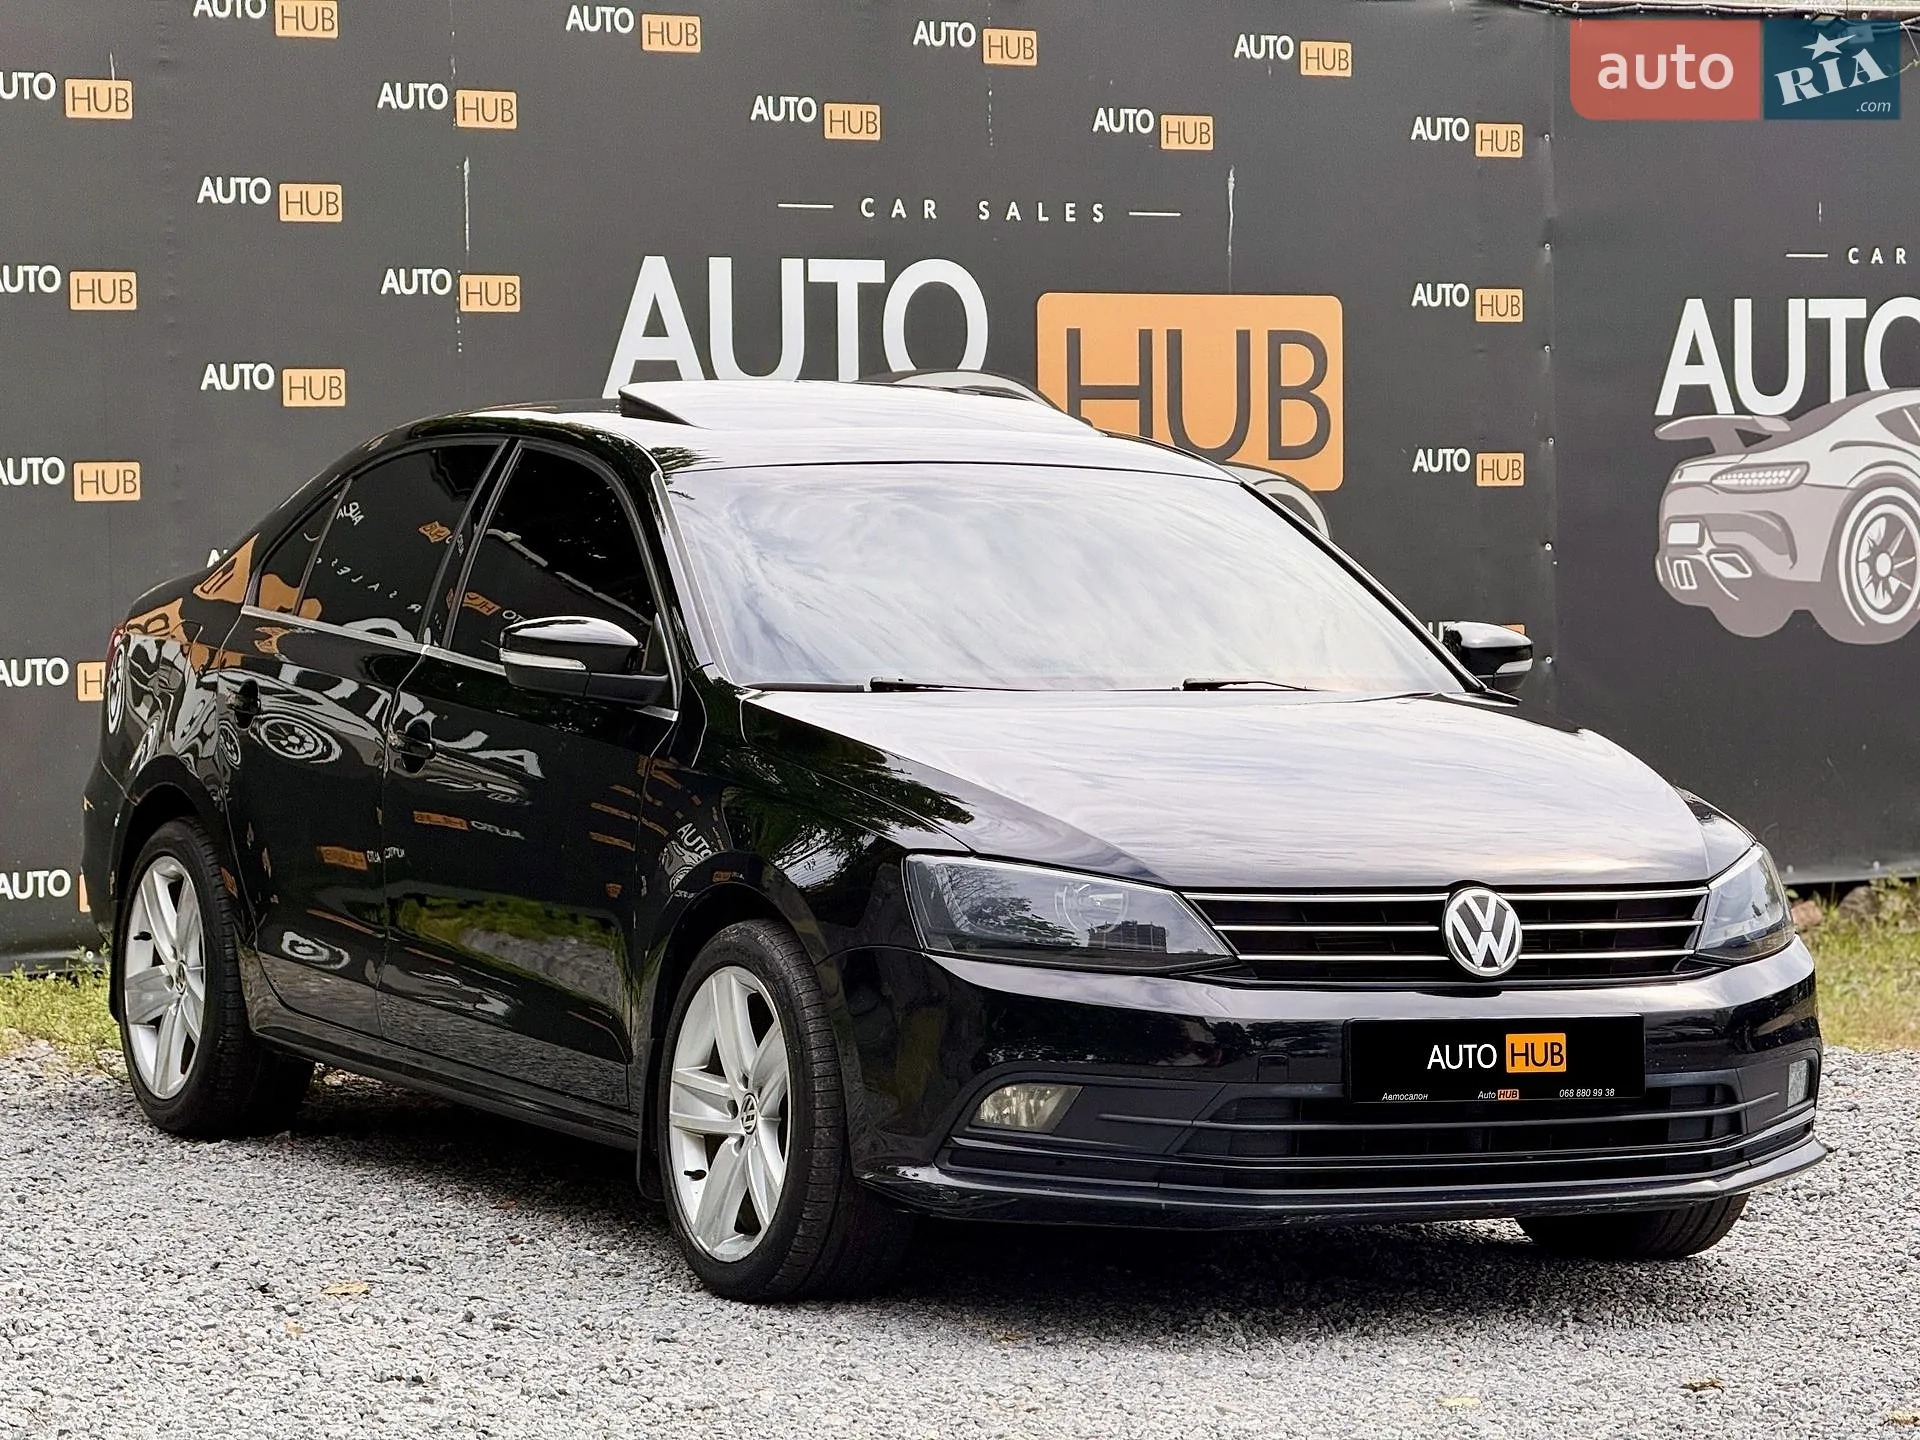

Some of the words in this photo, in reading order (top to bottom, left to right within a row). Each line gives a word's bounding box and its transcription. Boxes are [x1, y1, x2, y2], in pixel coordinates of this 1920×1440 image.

[193, 0, 266, 19] AUTO
[281, 5, 335, 32] HUB
[566, 5, 634, 33] AUTO
[648, 21, 698, 46] HUB
[913, 21, 976, 47] AUTO
[988, 35, 1034, 60] HUB
[1234, 34, 1294, 60] AUTO
[1305, 47, 1349, 71] HUB
[71, 86, 129, 112] HUB
[377, 83, 448, 110] AUTO
[462, 96, 514, 123] HUB
[751, 95, 816, 122] AUTO
[829, 109, 877, 134] HUB
[1093, 108, 1154, 133] AUTO
[1165, 120, 1211, 145] HUB
[1411, 117, 1469, 141] AUTO
[1480, 130, 1520, 153] HUB
[197, 177, 271, 204] AUTO
[285, 191, 340, 217] HUB
[860, 198, 938, 220] CAR
[979, 200, 1104, 224] SALES
[1847, 247, 1907, 265] CAR
[0, 265, 61, 293] UTO
[76, 279, 134, 304] HUB
[381, 269, 452, 295] AUTO
[465, 282, 517, 307] HUB
[1412, 283, 1469, 307] AUTO
[1480, 294, 1520, 318] HUB
[602, 256, 988, 398] AUTO
[1066, 328, 1331, 466] HUB
[201, 363, 274, 390] AUTO
[288, 376, 344, 401] HUB
[80, 469, 137, 495] HUB
[1412, 448, 1470, 472] AUTO
[1481, 458, 1523, 482] HUB
[1447, 890, 1518, 972] VW
[1427, 1044, 1498, 1070] AUTO
[1510, 1042, 1565, 1067] HUB
[1382, 1092, 1428, 1101] Автосалон
[1478, 1090, 1496, 1099] Auto
[1498, 1090, 1519, 1100] HUB
[1559, 1088, 1574, 1098] 068
[1576, 1088, 1591, 1097] 880
[1592, 1088, 1603, 1097] 99
[1605, 1088, 1615, 1097] 38
